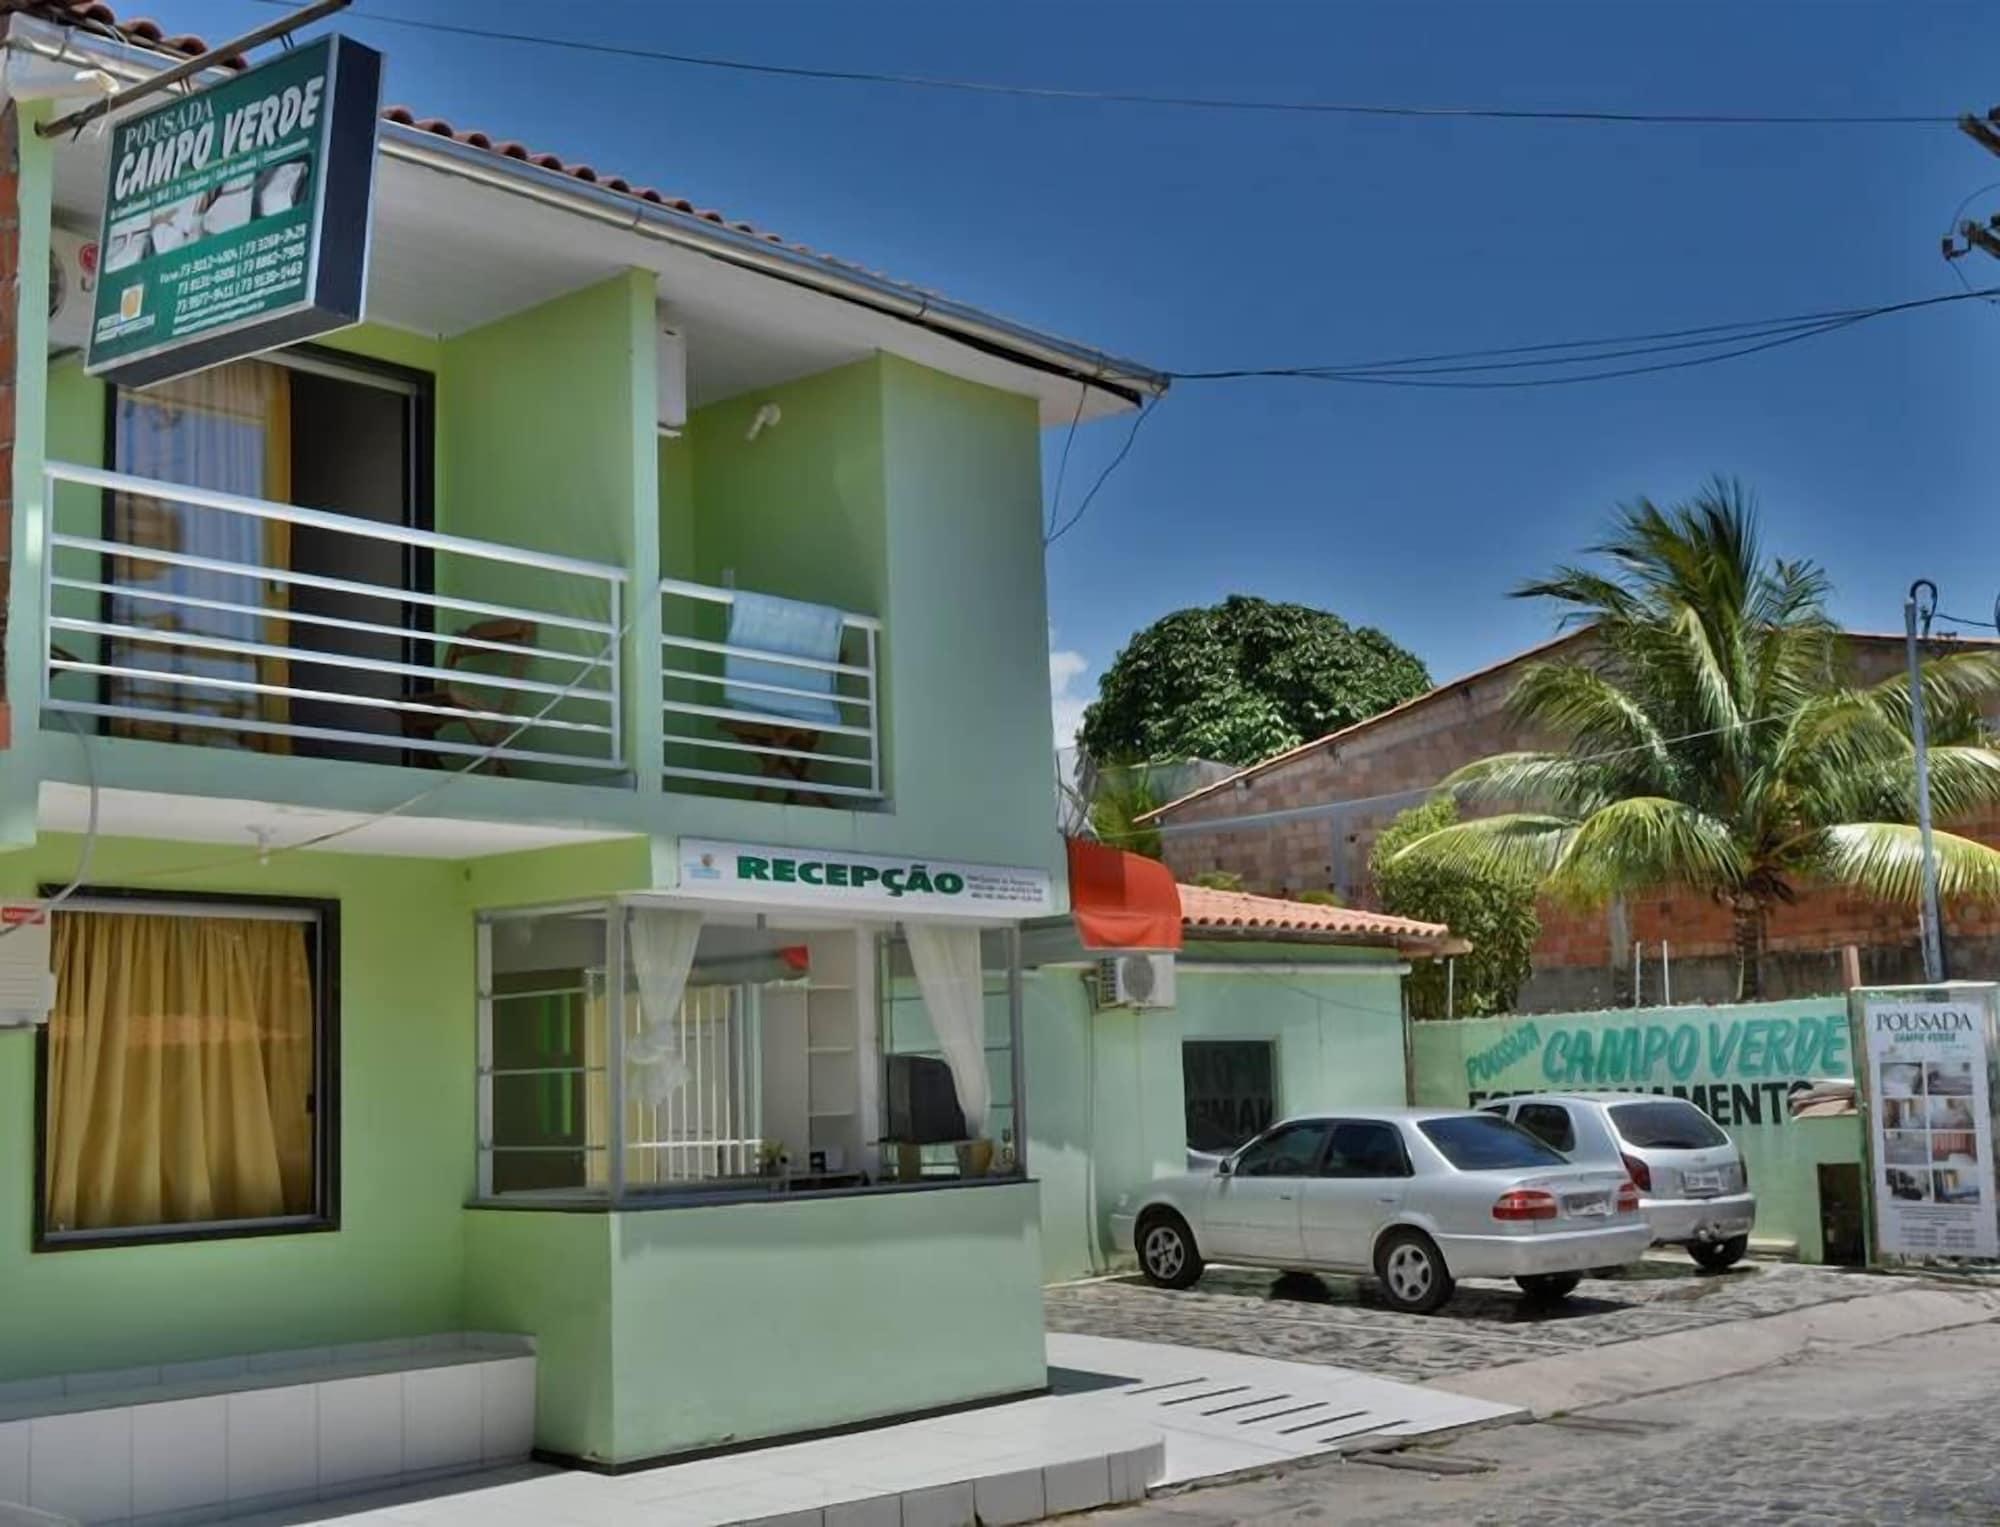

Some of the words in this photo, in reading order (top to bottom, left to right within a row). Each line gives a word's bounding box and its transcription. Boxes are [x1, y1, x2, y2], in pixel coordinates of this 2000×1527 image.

[115, 120, 215, 200] CAMPO
[222, 75, 325, 160] VERDE
[124, 97, 214, 152] POUSADA
[737, 855, 965, 897] RECEPÇÃO
[1876, 1012, 1973, 1031] POUSADA
[1542, 1023, 1699, 1084] CAMPO
[1708, 1015, 1849, 1079] VERDE
